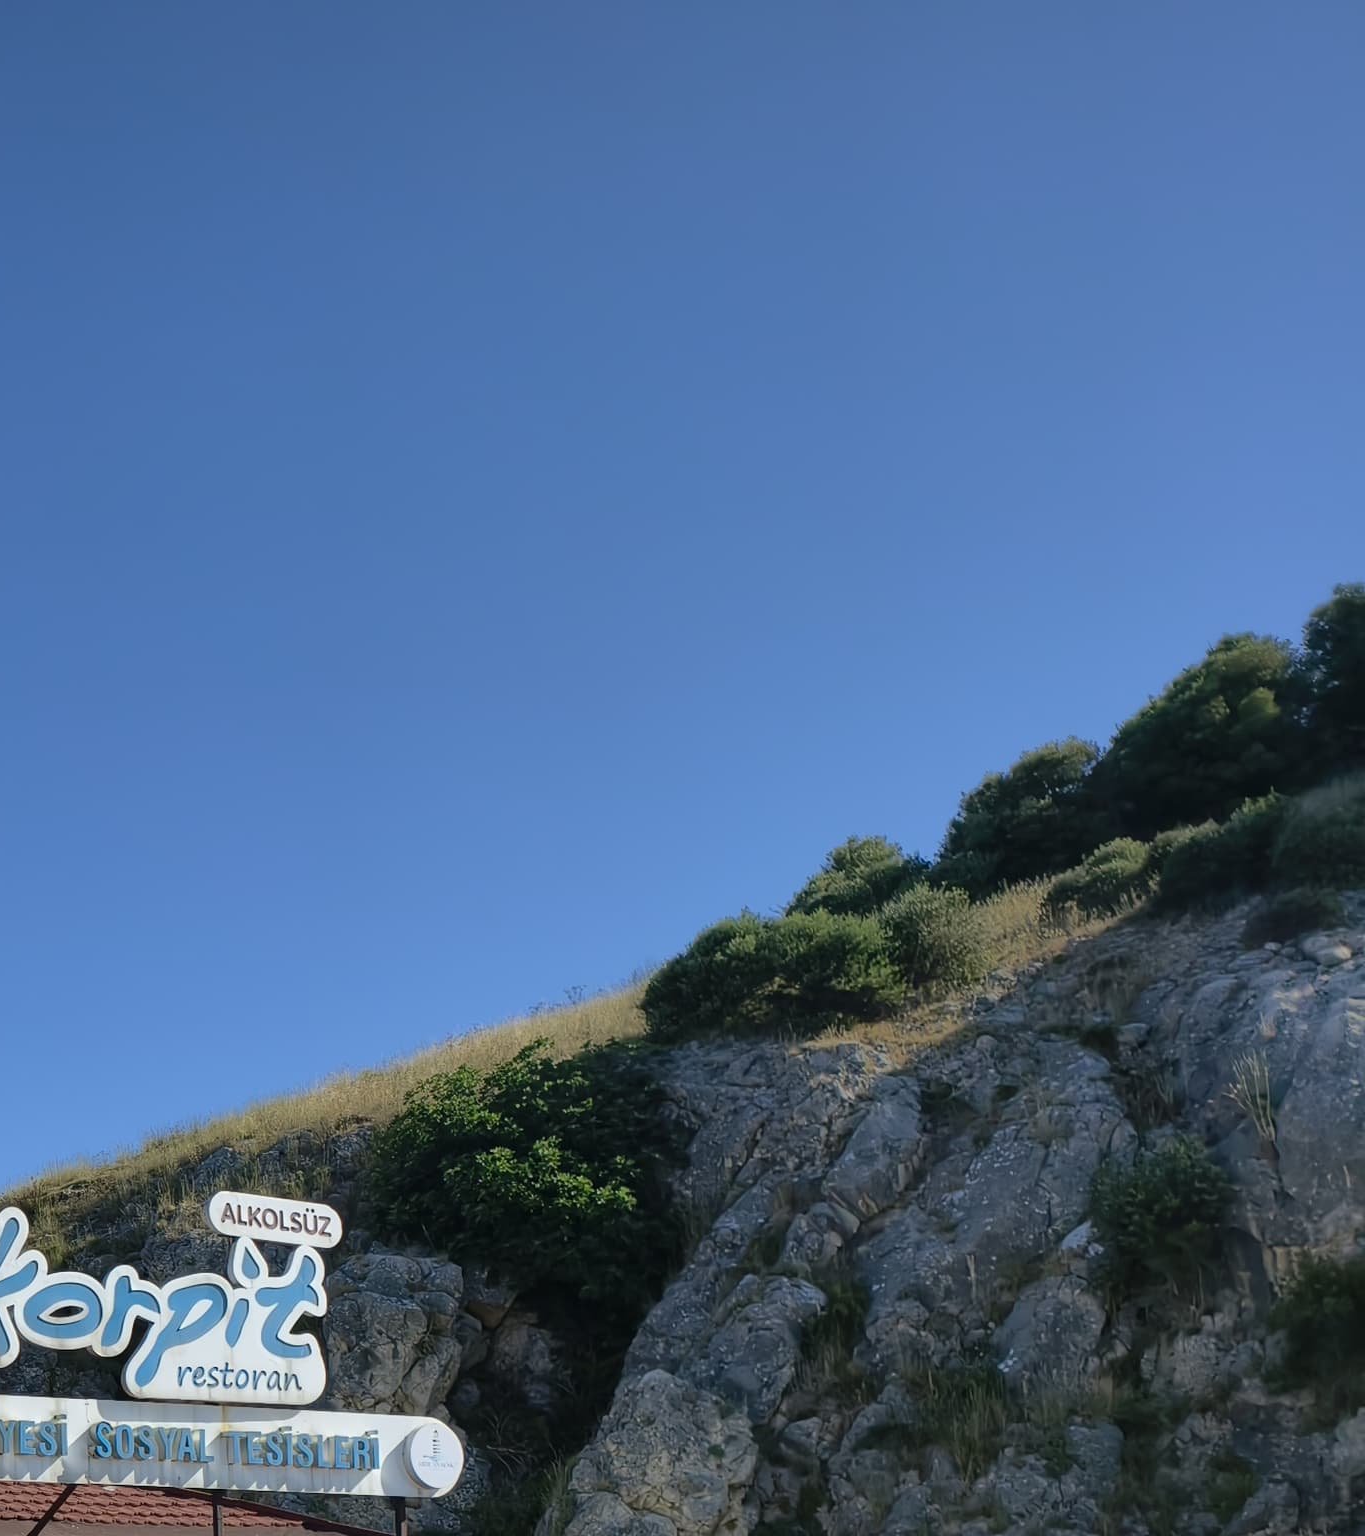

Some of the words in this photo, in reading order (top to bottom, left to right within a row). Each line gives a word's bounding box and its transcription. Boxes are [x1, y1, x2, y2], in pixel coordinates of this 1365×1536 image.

[220, 1202, 333, 1237] ALKOLSÜZ
[177, 1362, 302, 1391] restoran
[90, 1421, 215, 1463] SOSYAL
[221, 1426, 380, 1470] TESİSLERİ
